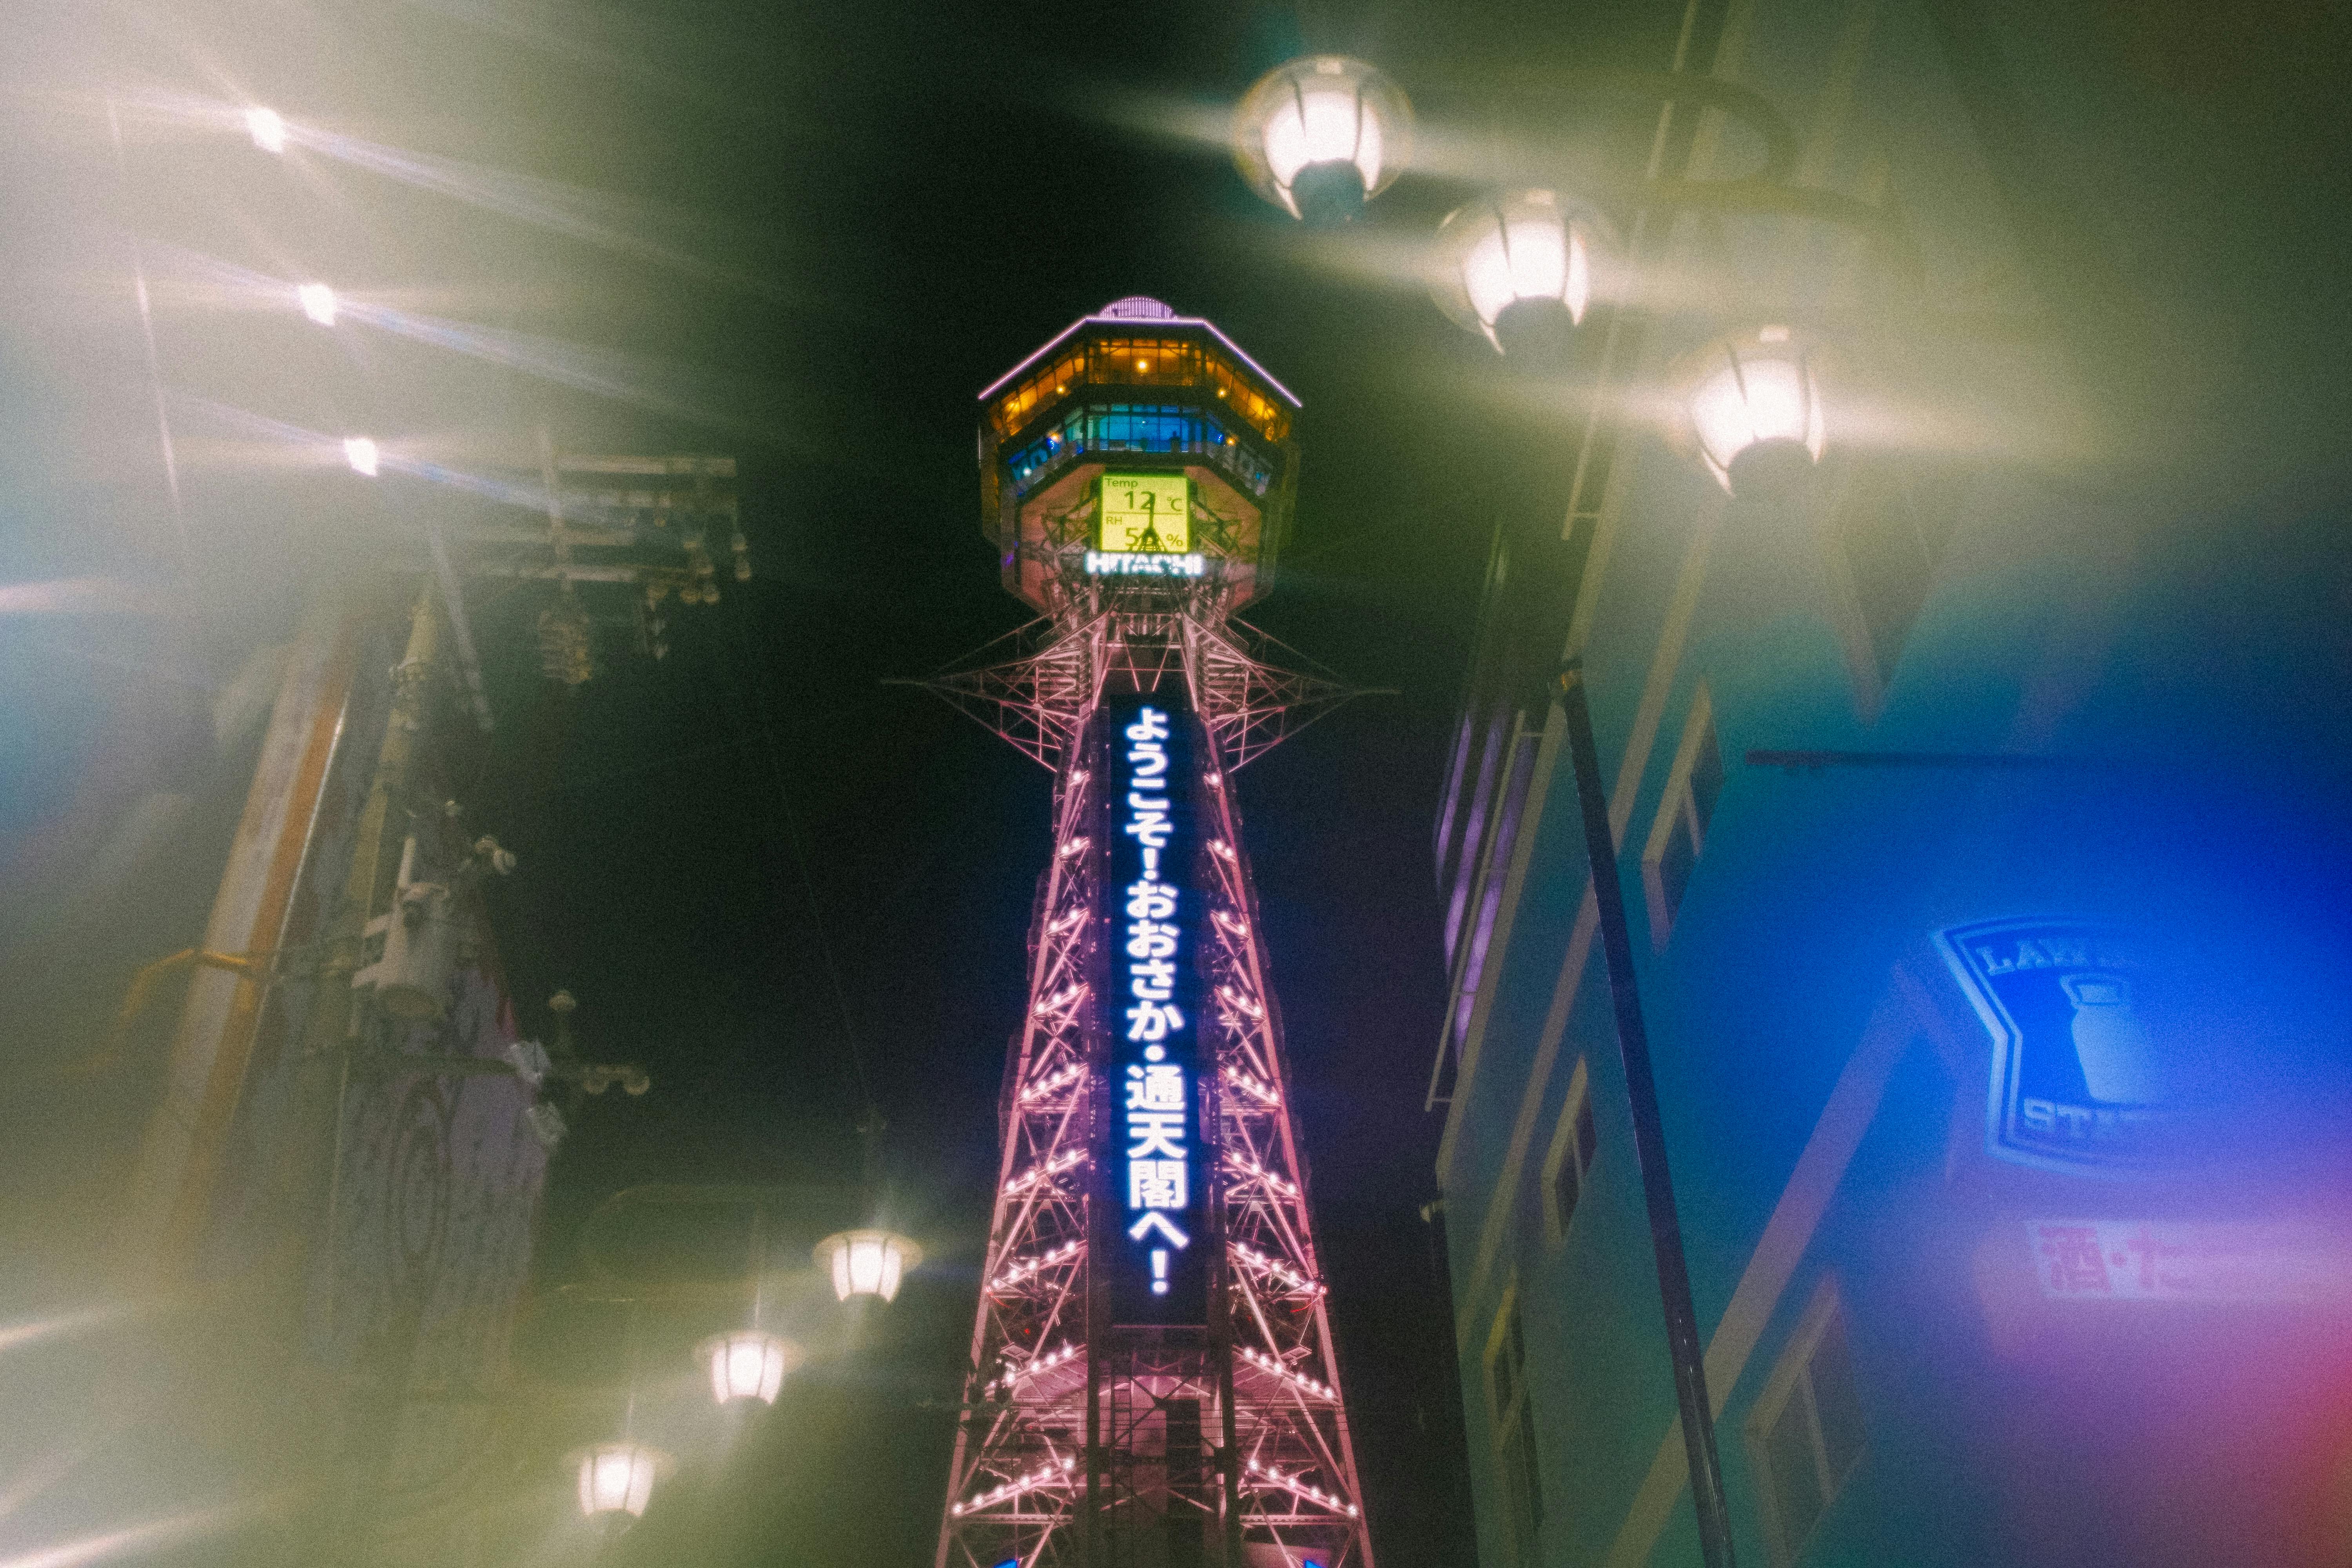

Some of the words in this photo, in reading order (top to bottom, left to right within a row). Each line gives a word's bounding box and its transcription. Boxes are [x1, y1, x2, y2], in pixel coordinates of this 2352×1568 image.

[1105, 478, 1138, 489] Temp
[1124, 491, 1156, 509] 12
[1106, 516, 1123, 525] RH
[1166, 533, 1184, 547] %
[1087, 552, 1203, 575] HITACHI
